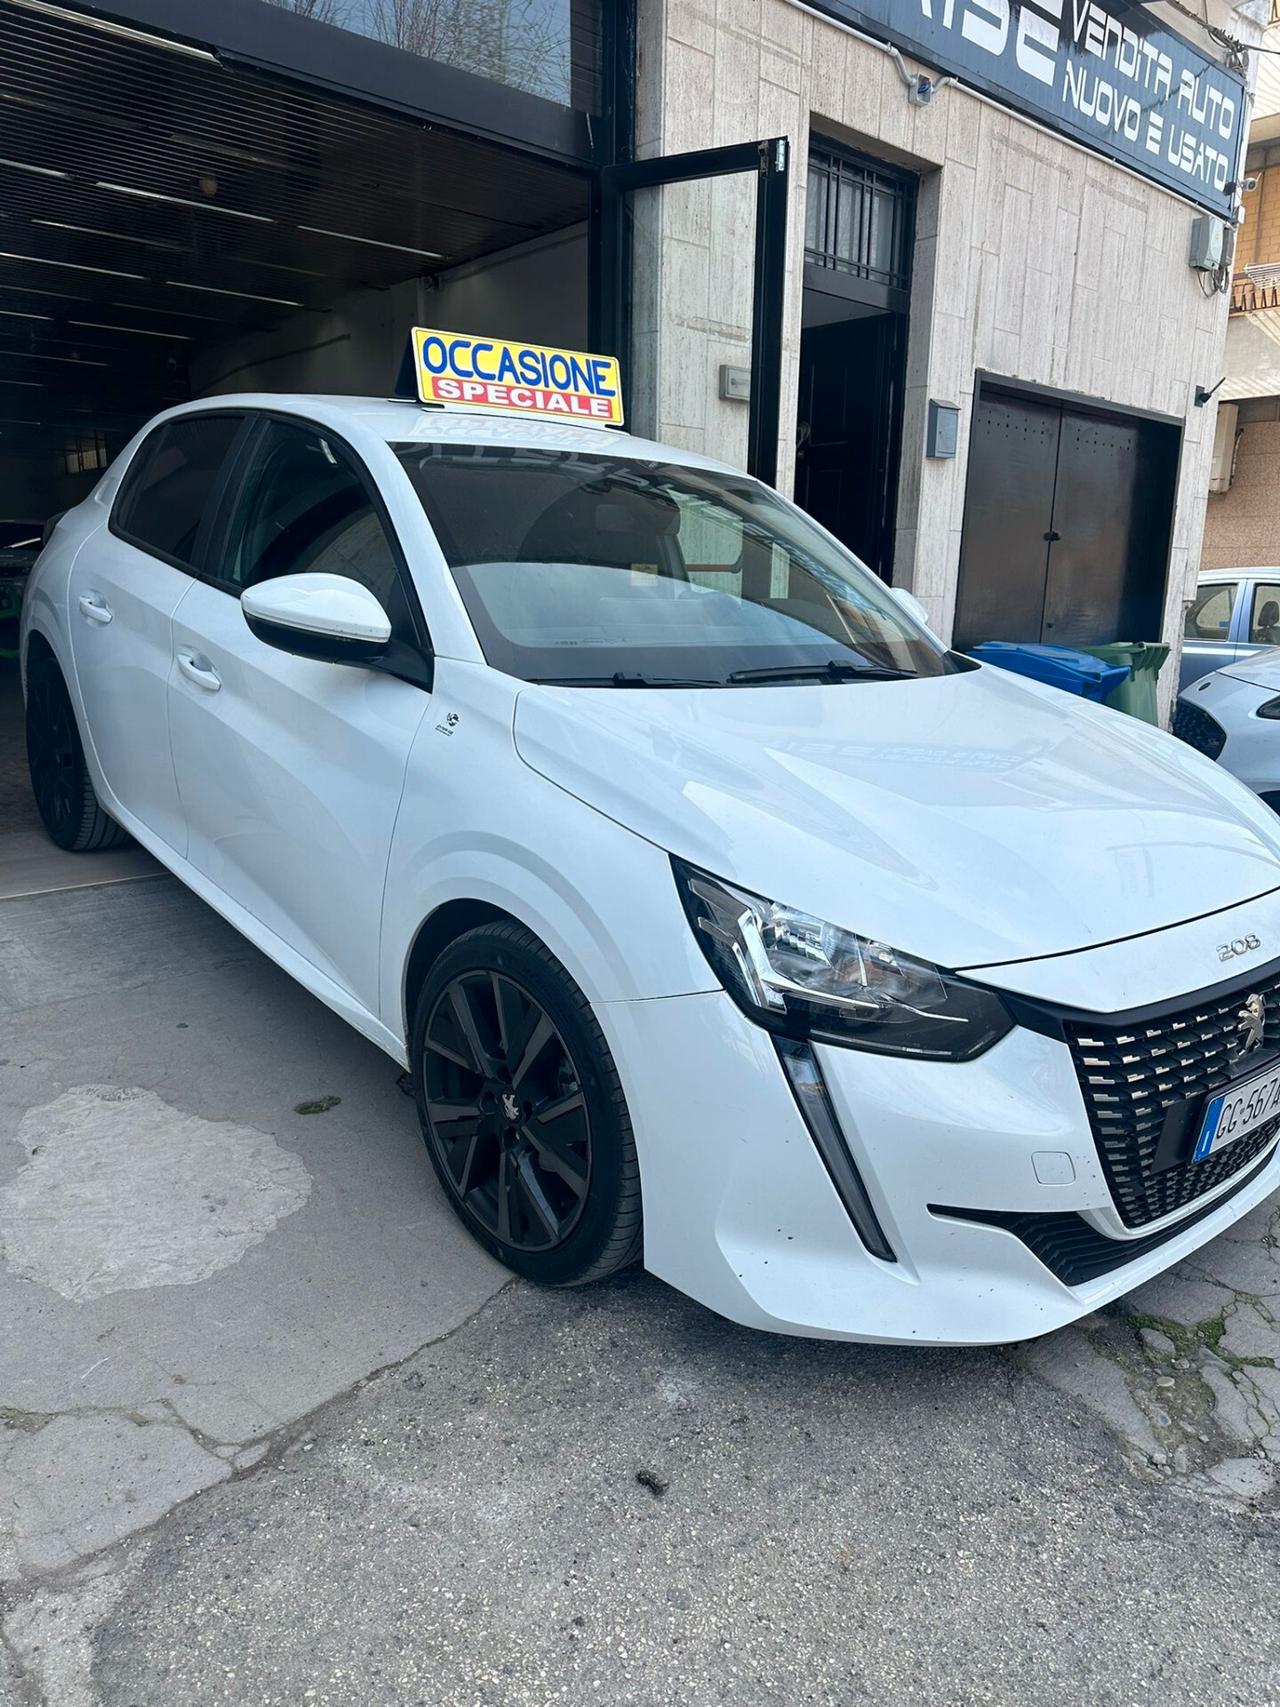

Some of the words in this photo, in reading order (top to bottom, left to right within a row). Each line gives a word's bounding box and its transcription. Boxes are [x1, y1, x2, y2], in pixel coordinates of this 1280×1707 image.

[1073, 0, 1173, 101] VENDITA
[1177, 69, 1235, 140] AUTO
[1063, 59, 1141, 142] NUOVO
[1146, 111, 1164, 155] E
[1168, 124, 1229, 192] USATO
[423, 336, 616, 397] OCCASIONE
[437, 379, 611, 417] SPECIALE
[1216, 933, 1262, 962] 208
